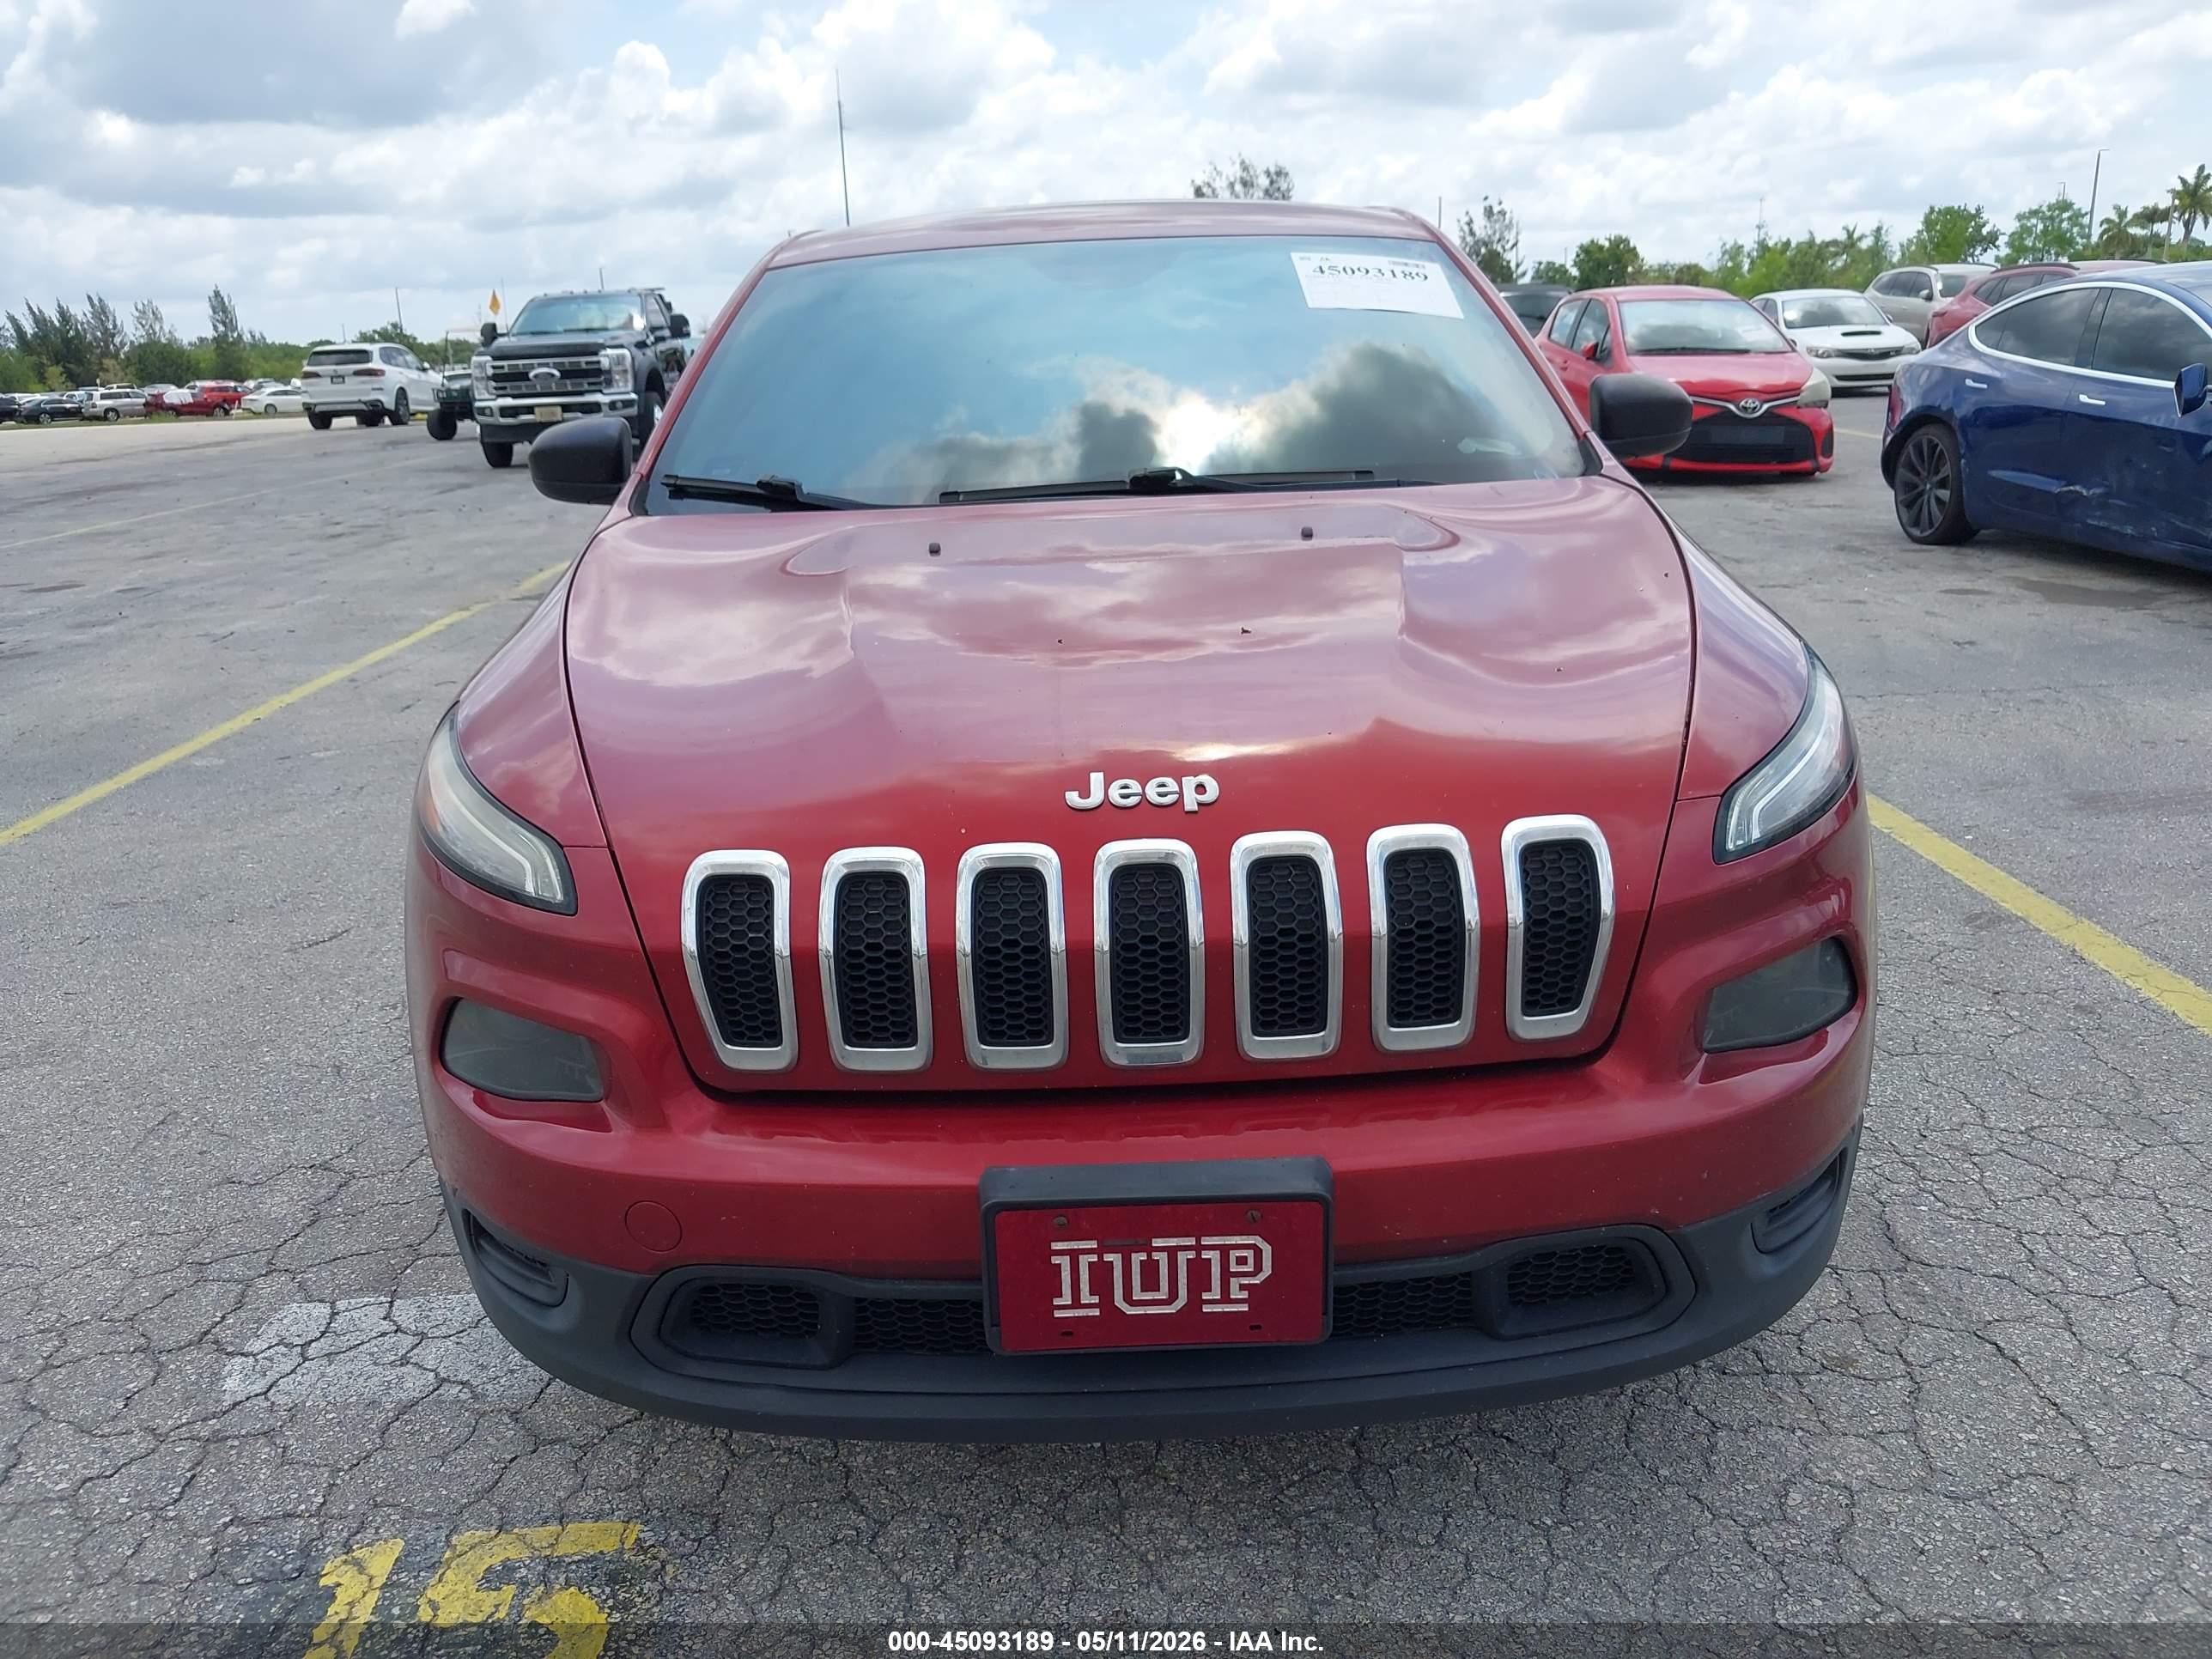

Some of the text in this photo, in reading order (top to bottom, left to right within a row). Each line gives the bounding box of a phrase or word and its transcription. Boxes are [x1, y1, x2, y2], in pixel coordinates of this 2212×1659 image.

[1311, 264, 1429, 282] 45093189
[1065, 772, 1219, 812] Jeep
[1050, 1235, 1273, 1317] IUP
